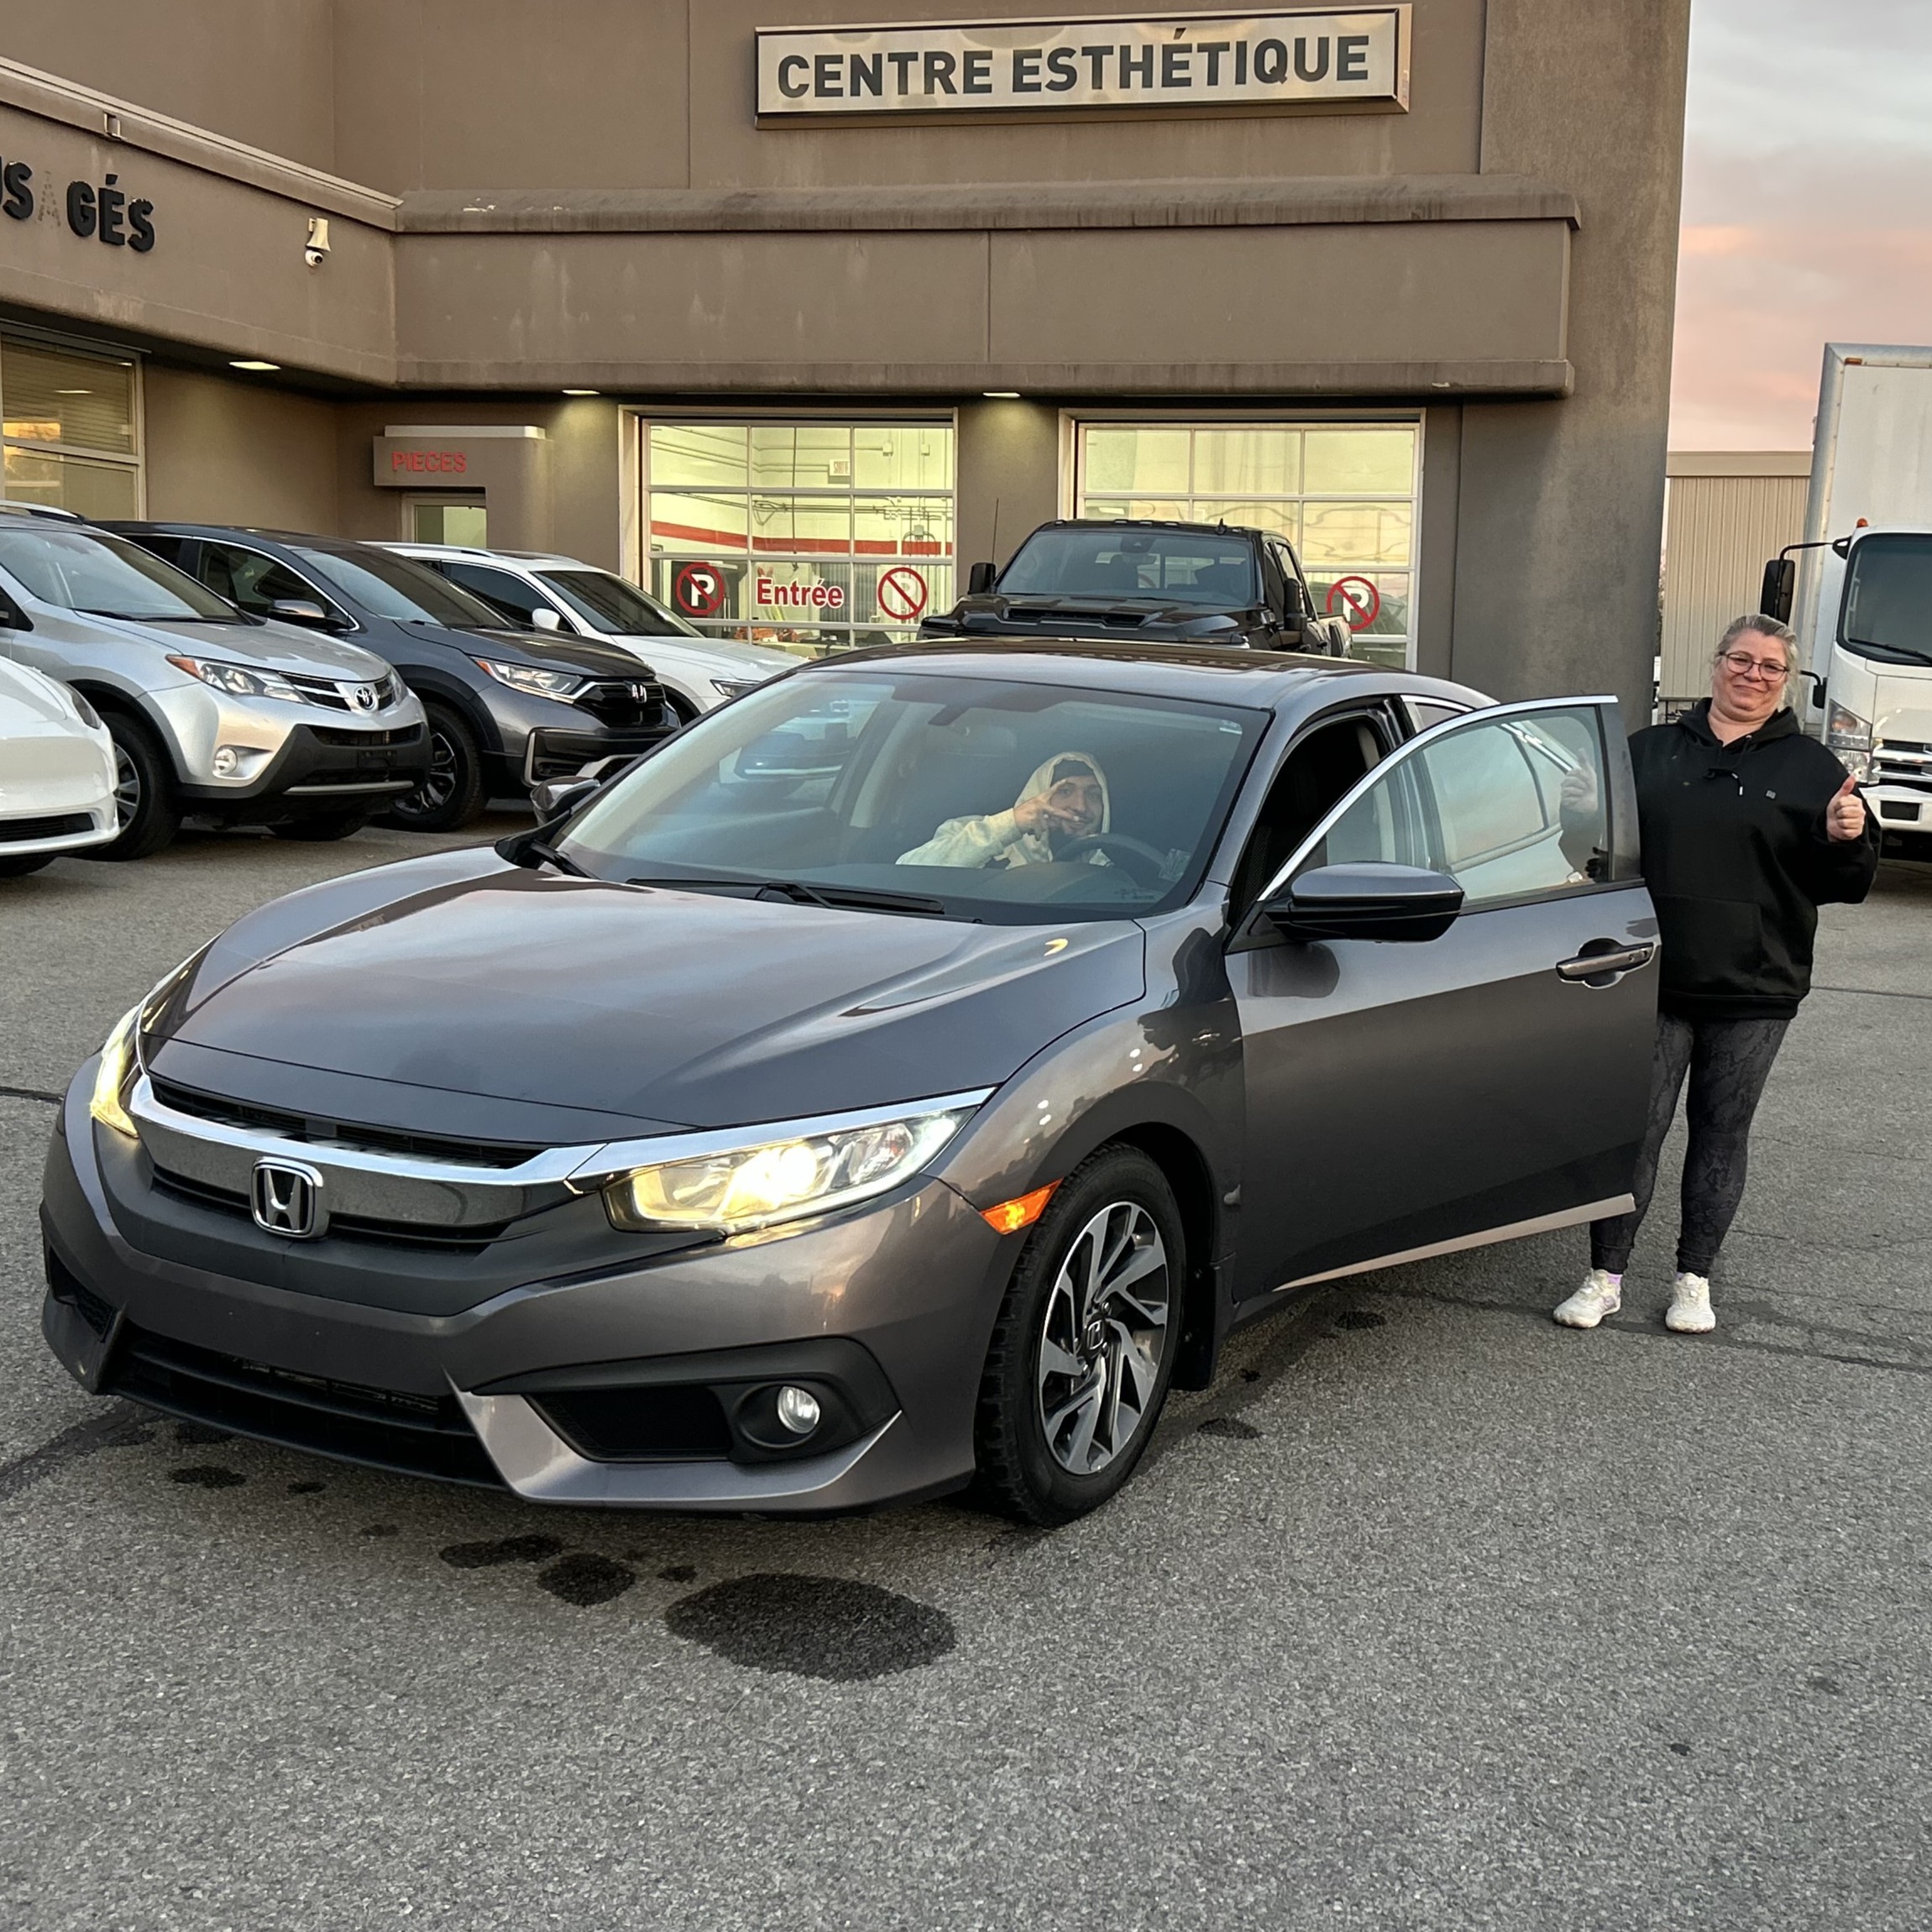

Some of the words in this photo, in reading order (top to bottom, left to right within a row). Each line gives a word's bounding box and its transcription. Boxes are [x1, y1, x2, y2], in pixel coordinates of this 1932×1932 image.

[778, 50, 993, 97] CENTRE
[1012, 28, 1369, 92] ESTHÉTIQUE
[757, 579, 844, 608] Entrée
